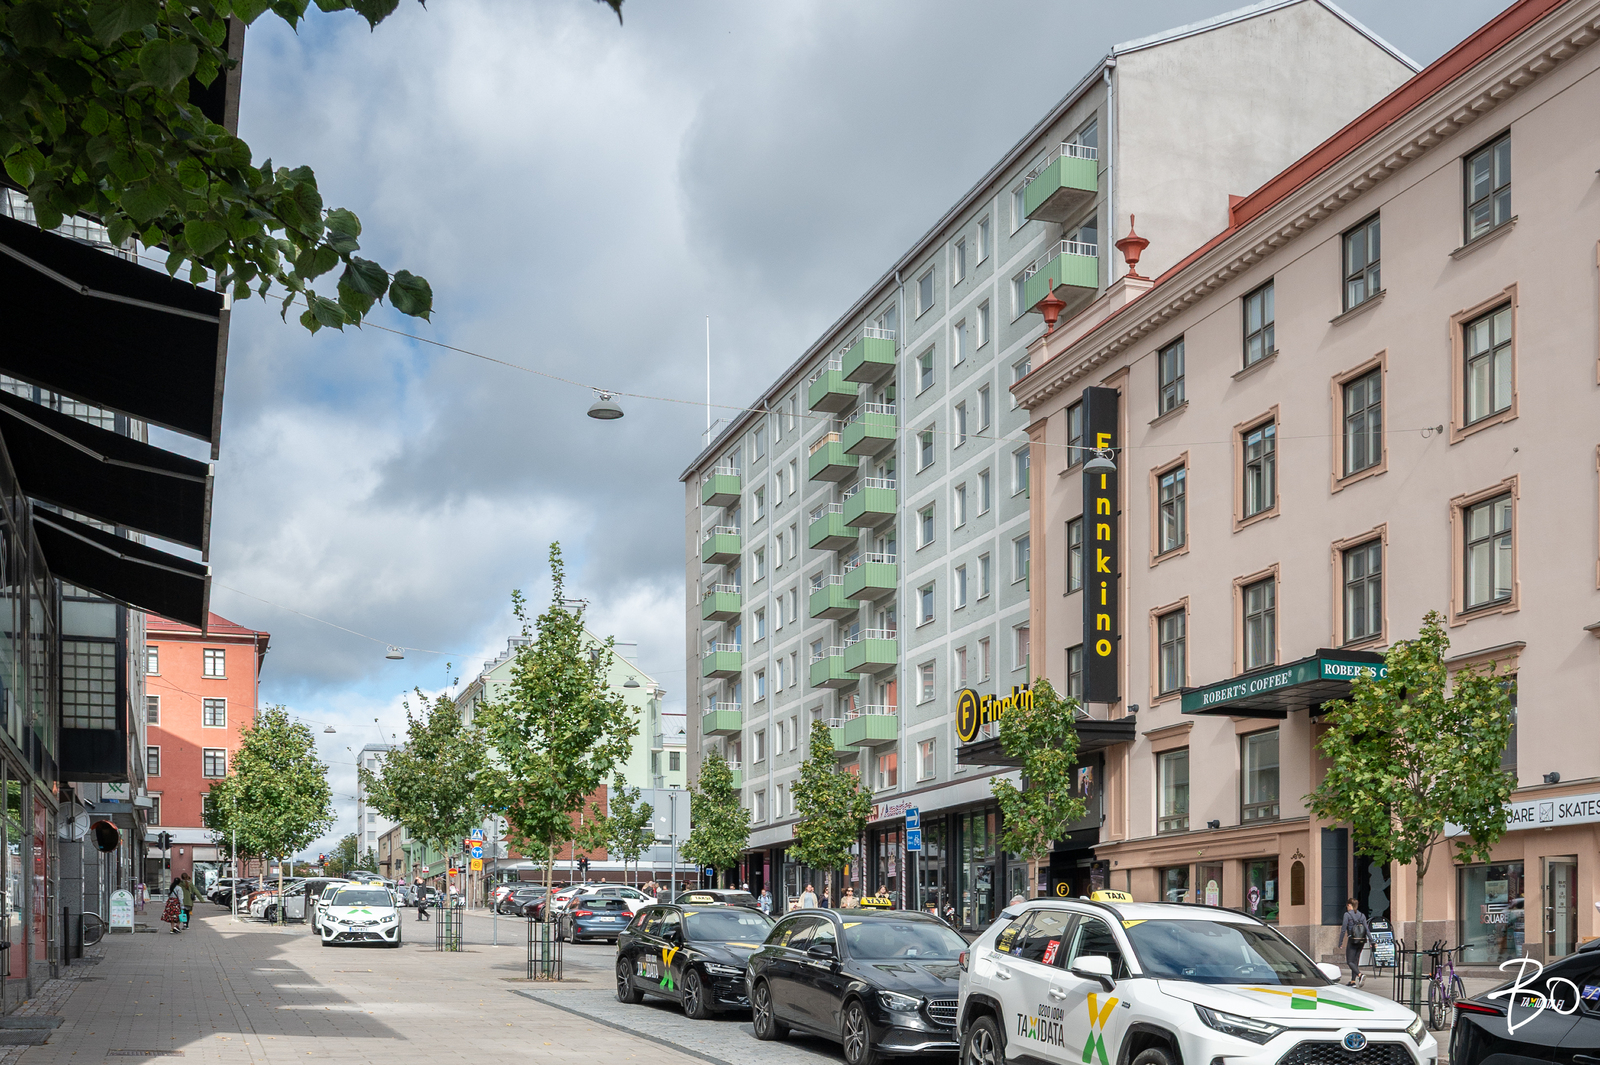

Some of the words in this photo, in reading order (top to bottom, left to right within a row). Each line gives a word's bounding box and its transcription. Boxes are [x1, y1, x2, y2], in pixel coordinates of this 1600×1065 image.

[1096, 432, 1112, 657] Finnkino
[980, 683, 1034, 725] Finnkin
[1203, 683, 1247, 705] ROBERT'S
[1558, 800, 1600, 819] SKATES
[1105, 891, 1126, 901] TAXI
[1480, 913, 1509, 924] SQUARE
[1017, 1013, 1065, 1048] TAXIDATA
